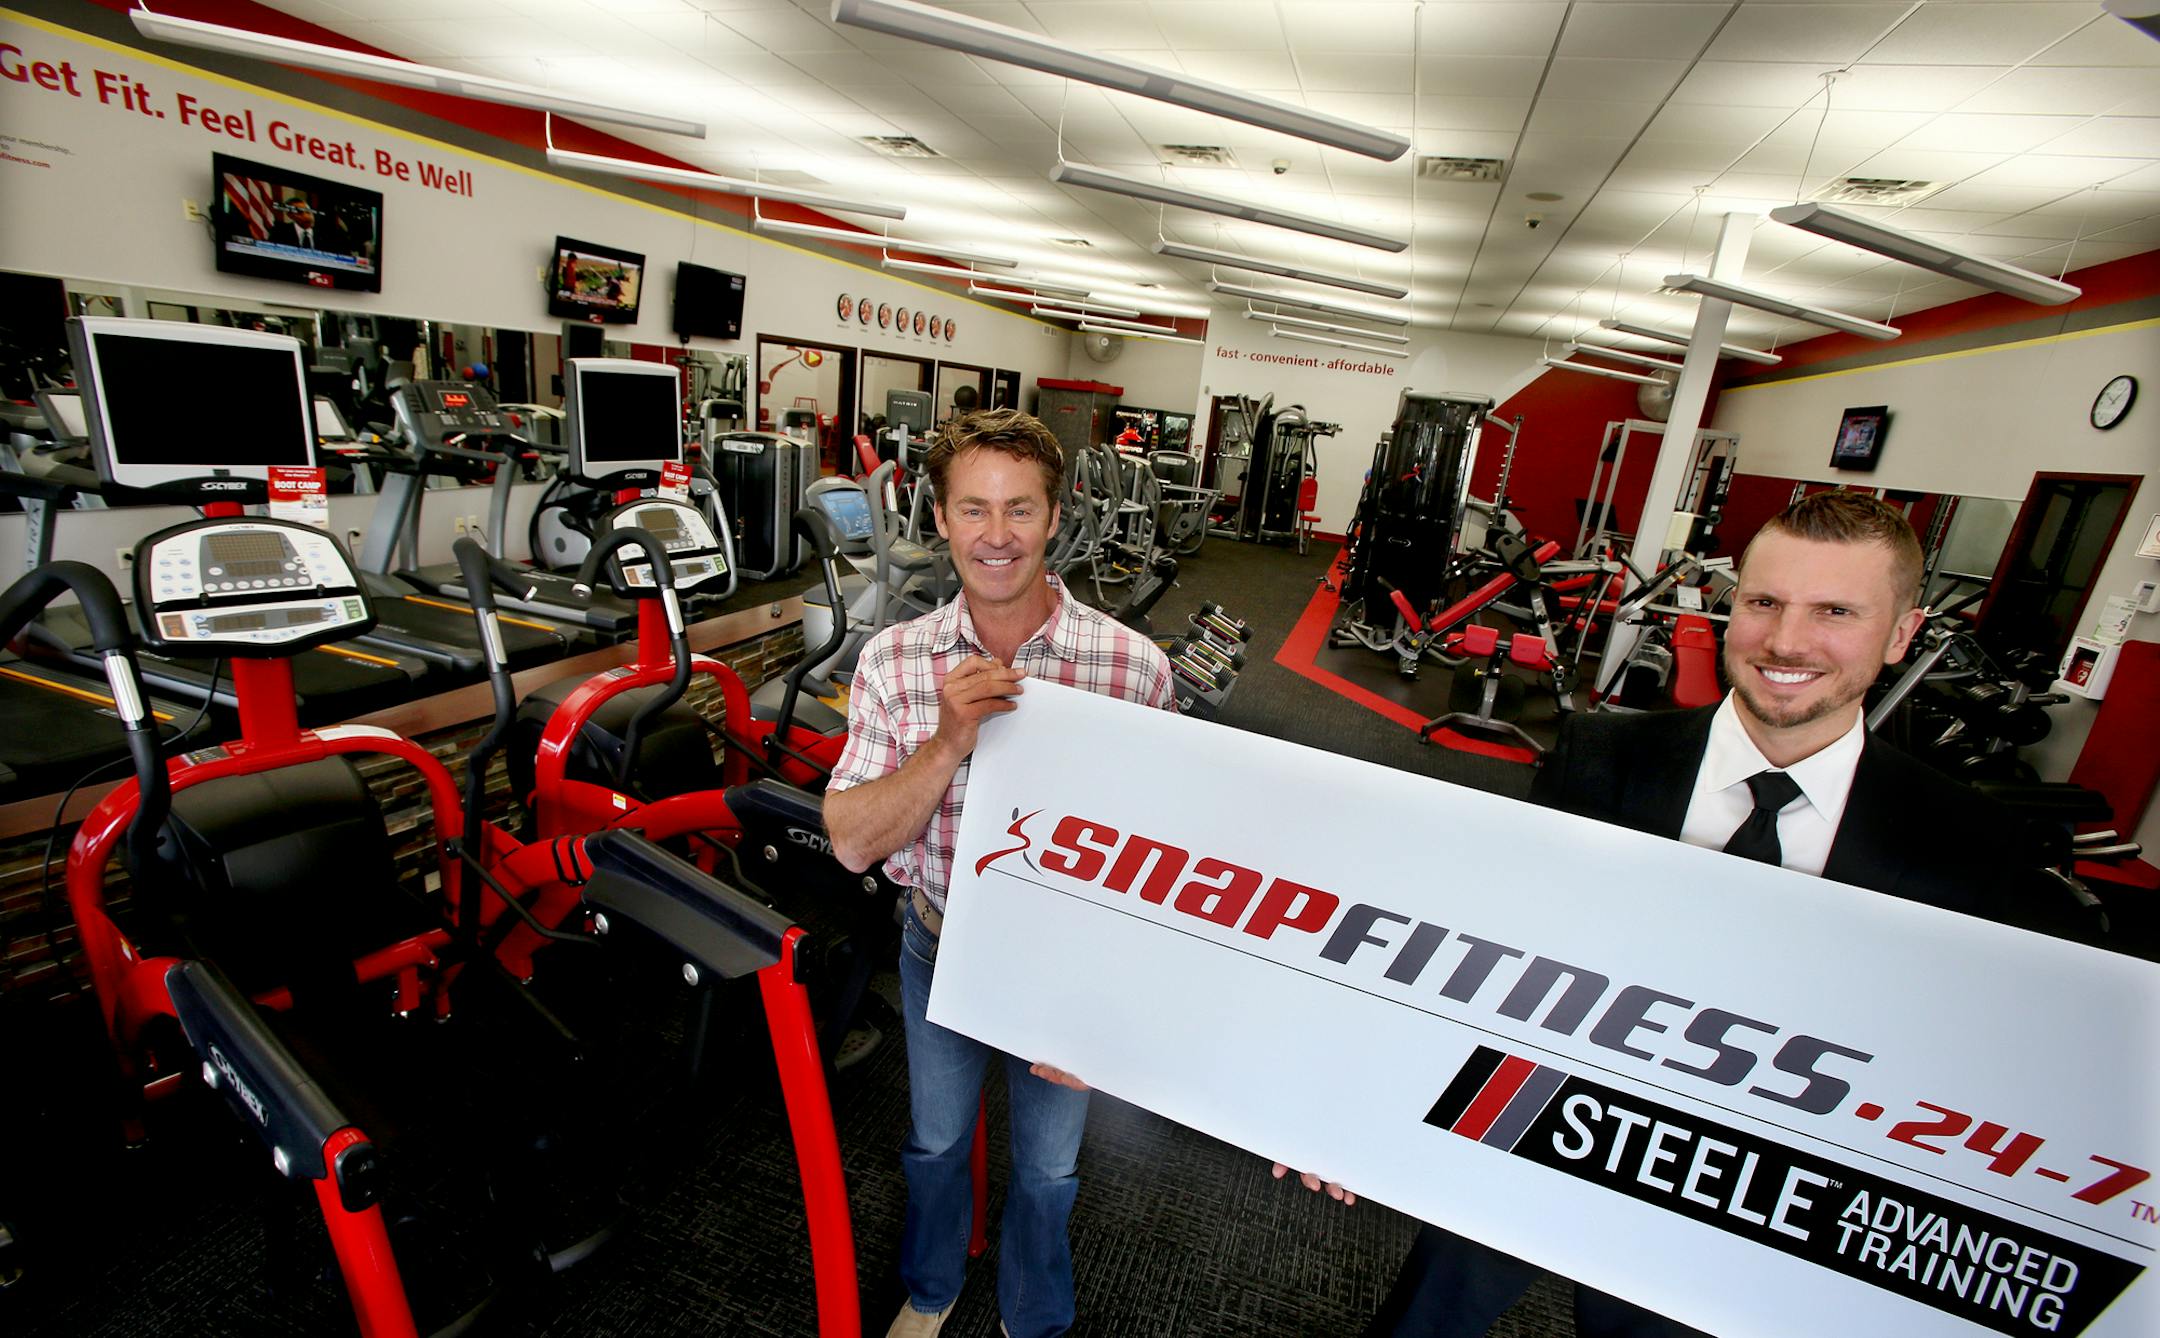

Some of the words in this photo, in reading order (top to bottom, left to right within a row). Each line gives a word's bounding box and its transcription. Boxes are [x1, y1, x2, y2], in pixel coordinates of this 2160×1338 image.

[0, 42, 82, 98] Get
[94, 69, 166, 119] Fit.
[176, 92, 256, 142] Feel
[268, 120, 366, 171] Great.
[374, 148, 411, 182] Be
[417, 160, 474, 198] Well
[1216, 345, 1239, 359] fast
[1250, 351, 1319, 368] convenient
[1327, 358, 1395, 376] affordable
[212, 481, 248, 490] CYBEX
[274, 481, 297, 490] BOOT
[297, 481, 321, 490] CAMP
[221, 1057, 266, 1124] CYBEX
[1552, 1094, 1830, 1241] STEELE
[1836, 1219, 2065, 1331] TRAINING
[1841, 1190, 2079, 1294] ADVANCED
